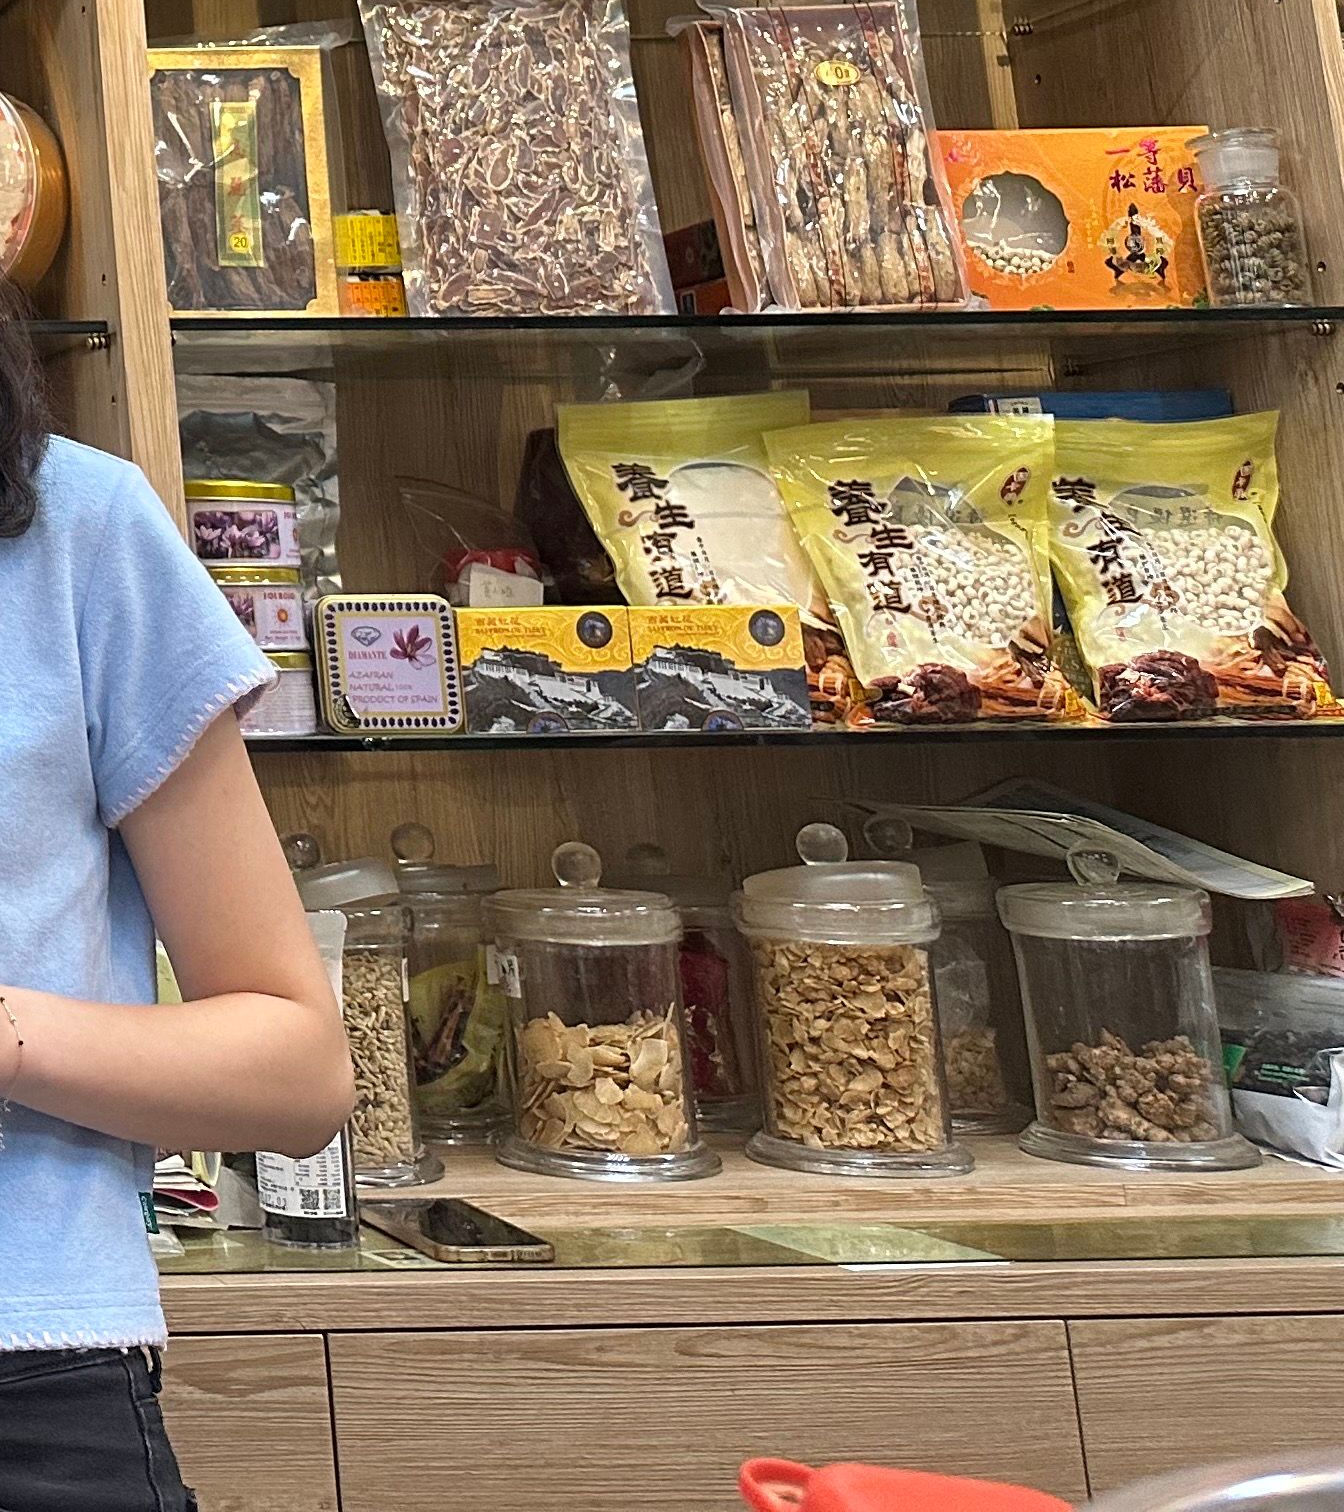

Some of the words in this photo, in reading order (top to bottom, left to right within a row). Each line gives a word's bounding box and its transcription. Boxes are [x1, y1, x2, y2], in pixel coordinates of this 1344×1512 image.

[233, 236, 248, 249] 20
[611, 461, 695, 600] 養生有道
[827, 479, 913, 615] 養生有道
[348, 650, 386, 661] DIAMANTE
[348, 670, 394, 680] AZAFRAN
[349, 682, 395, 693] NATURAL
[352, 694, 395, 704] PRODUCT
